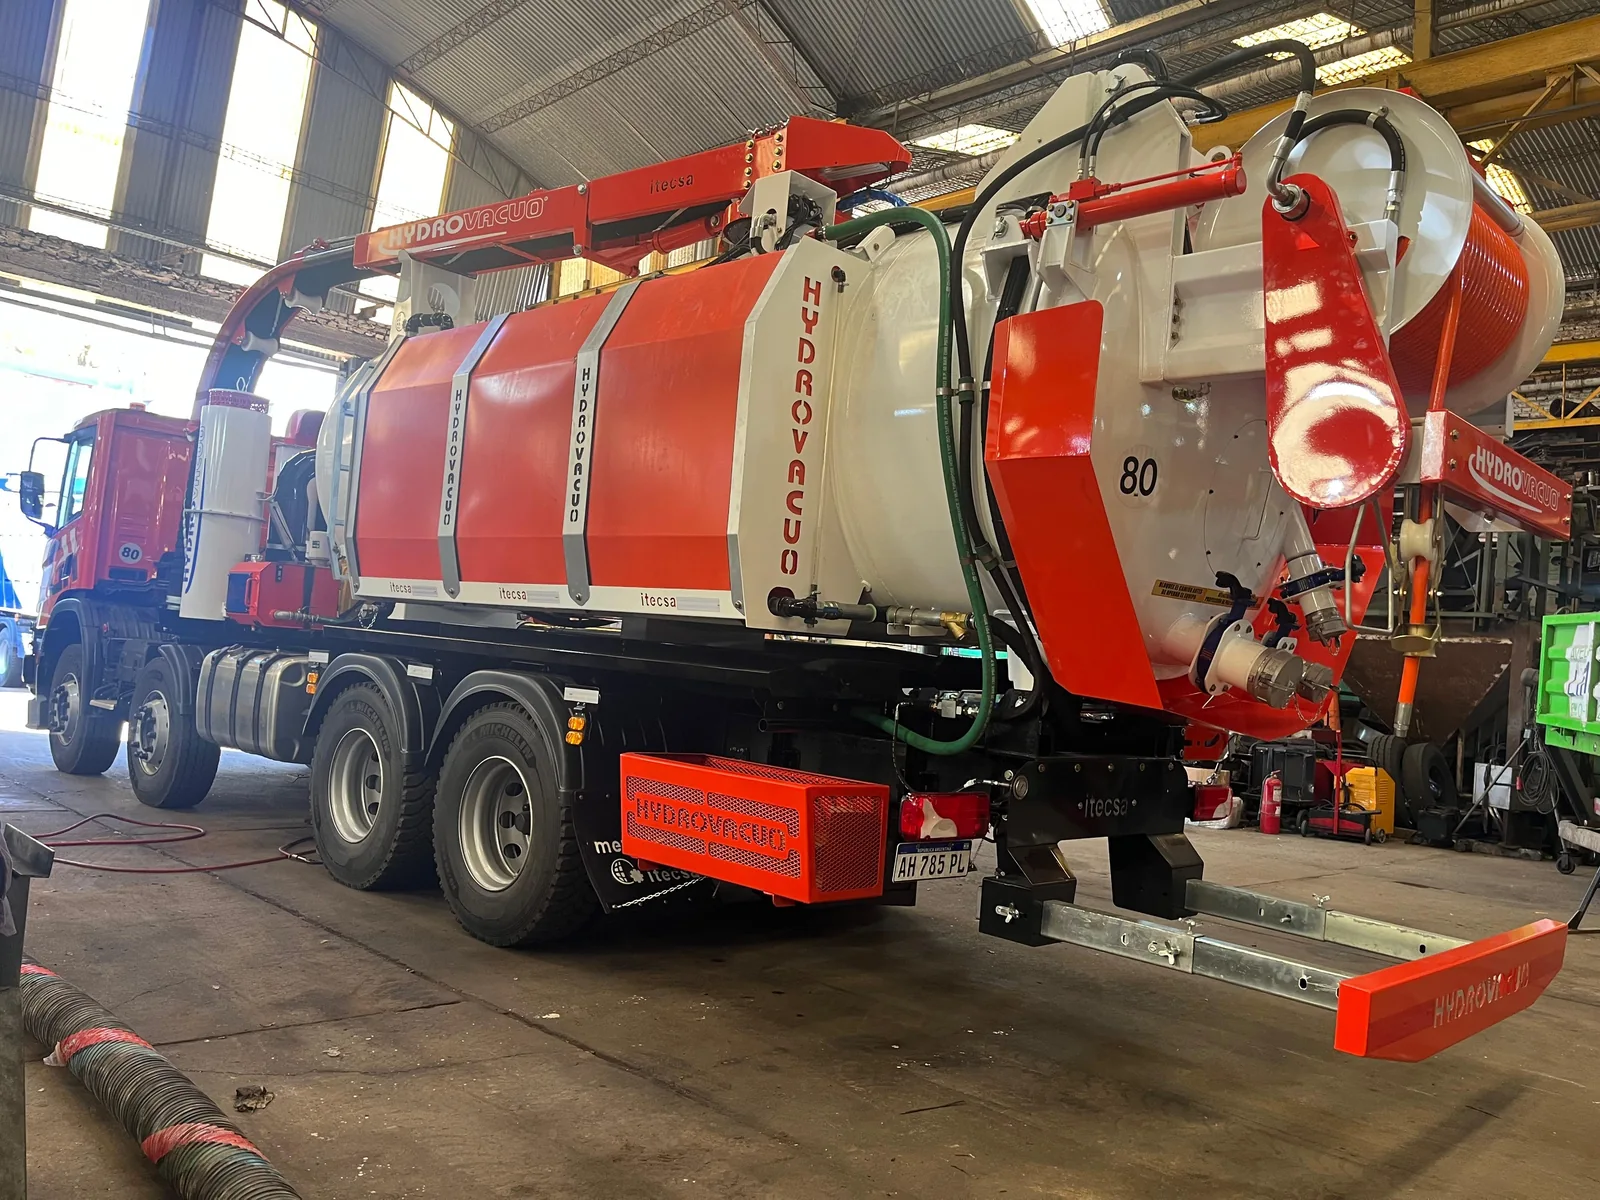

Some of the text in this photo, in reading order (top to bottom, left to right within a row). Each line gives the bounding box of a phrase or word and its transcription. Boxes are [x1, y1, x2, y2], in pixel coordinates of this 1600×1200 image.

[650, 173, 694, 195] itecsa
[780, 275, 821, 576] HYDROVACUO
[443, 389, 462, 526] HYDROVACUO
[569, 367, 591, 523] HYDROVACUO
[1120, 455, 1158, 497] 80
[1475, 445, 1559, 512] HYDROVACUO
[121, 546, 140, 561] 80
[390, 581, 412, 594] itecsa
[499, 587, 527, 600] itecsa
[640, 592, 676, 608] itecsa
[355, 701, 392, 753] MICHELIN
[479, 724, 534, 761] MICHELIN
[1084, 792, 1128, 818] itecsa
[636, 798, 786, 852] HYDROVACUO
[594, 840, 622, 854] me
[898, 853, 965, 878] AH 785 PL
